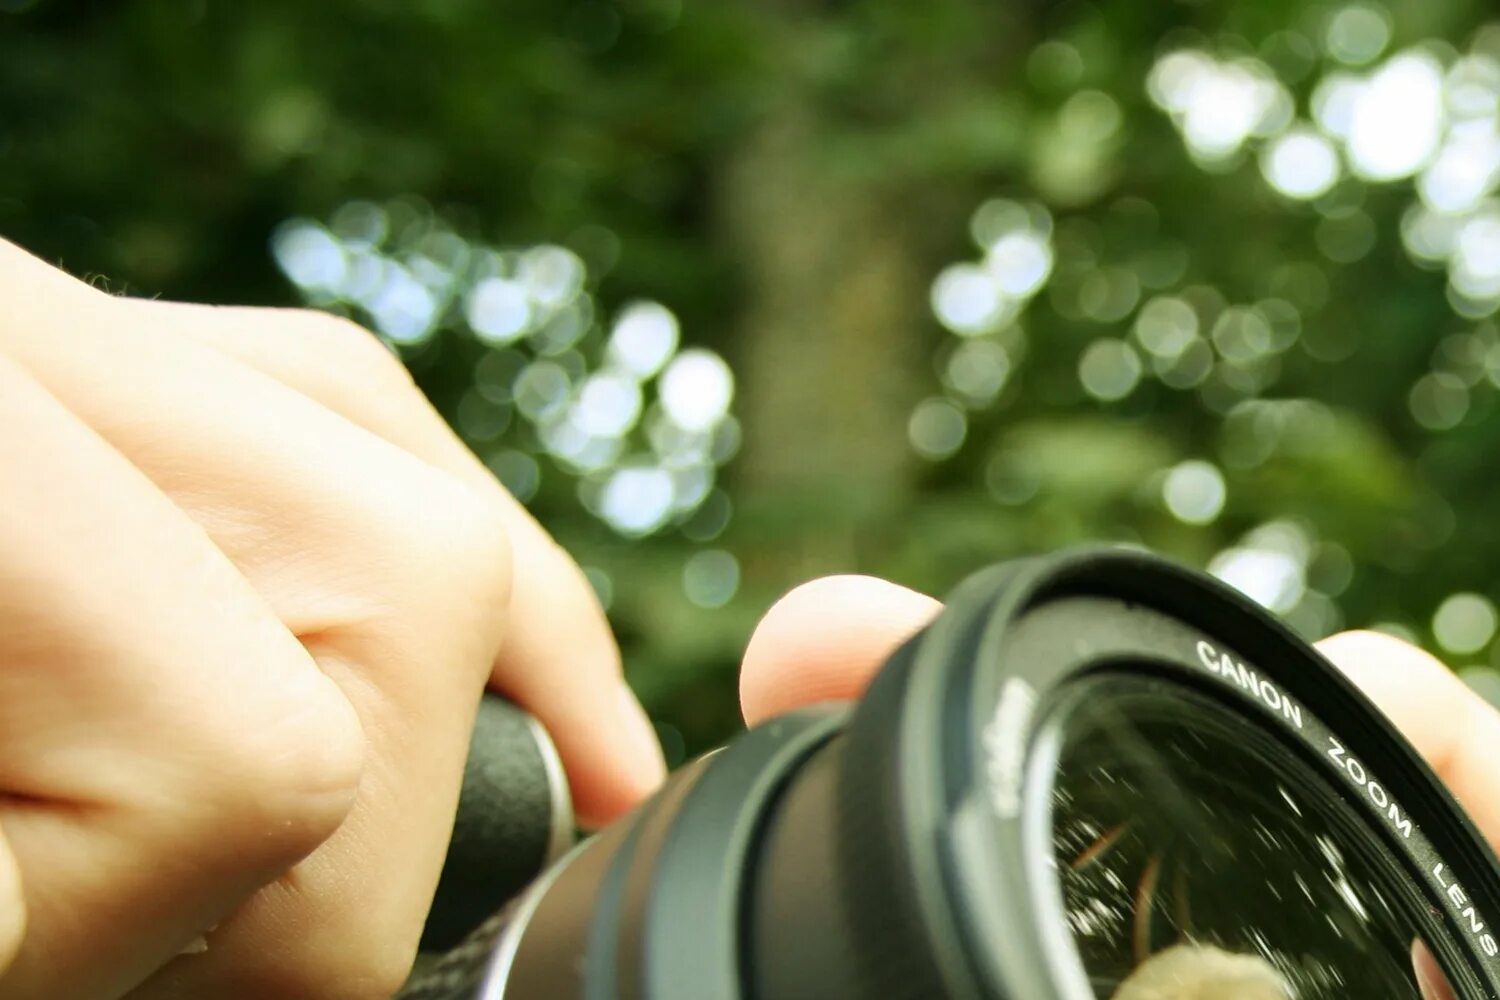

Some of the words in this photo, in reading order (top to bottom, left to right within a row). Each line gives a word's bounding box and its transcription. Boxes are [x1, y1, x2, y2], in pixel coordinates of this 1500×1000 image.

[1197, 640, 1302, 728] CANON
[1328, 736, 1412, 838] ZOOM
[1433, 862, 1498, 957] LENS
